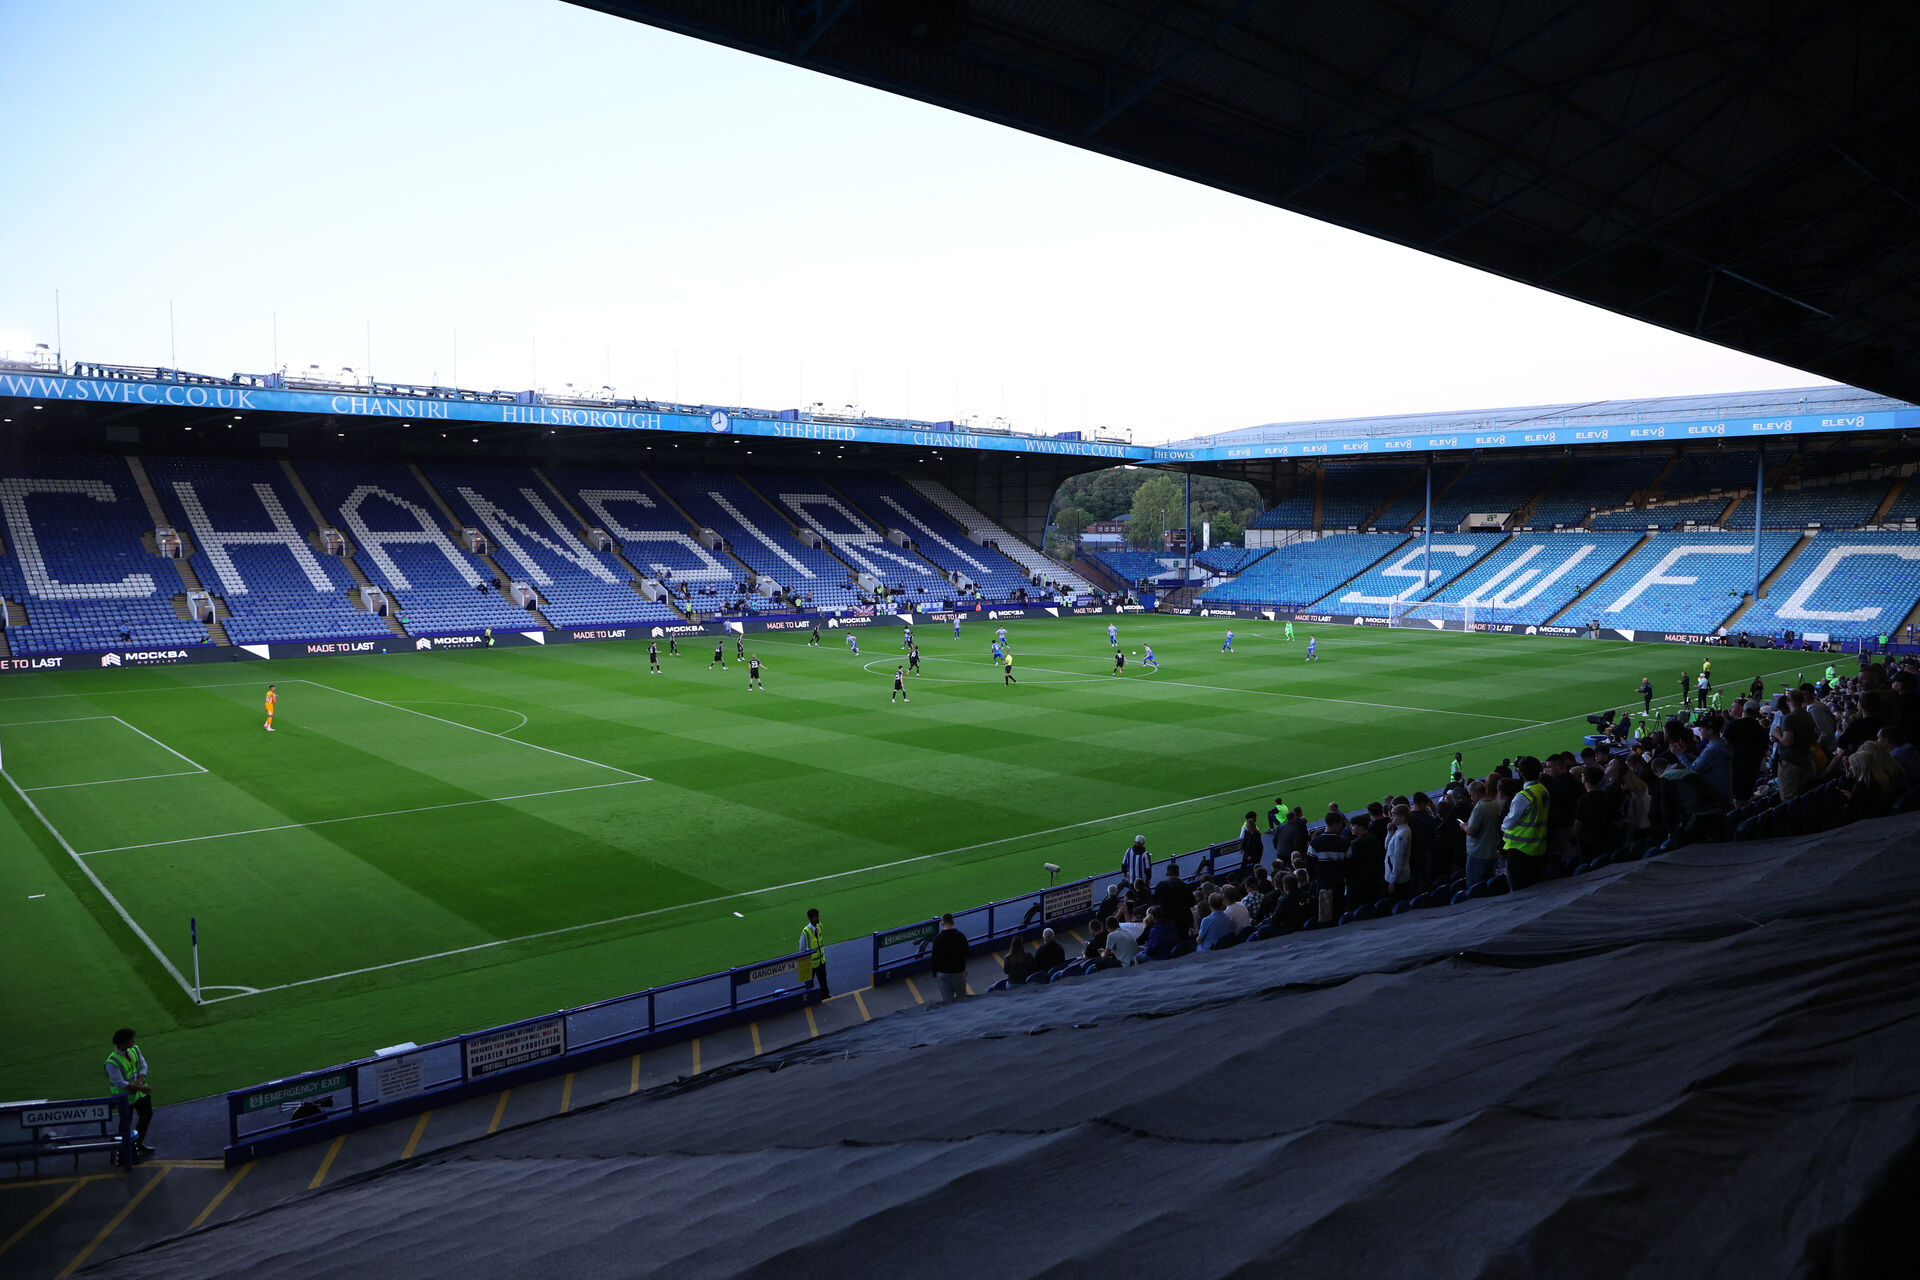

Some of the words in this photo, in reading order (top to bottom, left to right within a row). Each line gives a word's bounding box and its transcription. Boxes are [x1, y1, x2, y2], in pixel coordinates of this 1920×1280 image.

[0, 375, 256, 409] WW.SWFC.CO.UK
[331, 395, 448, 419] CHANSIRI
[502, 405, 661, 430] HILLSBOROUGH
[1822, 416, 1865, 428] ELEV8
[773, 422, 856, 441] SHEFFIELD
[1688, 424, 1726, 435] ELEV8
[1753, 420, 1792, 432] ELEV8
[1525, 432, 1556, 443] ELEV8
[1576, 430, 1609, 440] ELEV8
[1630, 427, 1665, 438] ELEV8
[913, 432, 978, 448] CHANSIRI
[1385, 439, 1412, 449] ELEV8
[1430, 437, 1458, 447] ELEV8
[1476, 435, 1506, 446] ELEV8
[1025, 440, 1125, 458] WWW.SWFC.CO.UK
[1265, 446, 1288, 455] ELEV8
[1303, 444, 1327, 454] ELEV8
[1343, 442, 1368, 451] ELEV8
[1170, 451, 1194, 459] OWLS
[1229, 448, 1251, 457] ELEV8
[665, 625, 704, 633] MOCKBA
[795, 620, 810, 628] LAST
[573, 630, 597, 639] MADE
[597, 630, 606, 638] TO
[607, 629, 626, 638] LAST
[1539, 626, 1577, 634] MOCKBA
[434, 636, 482, 645] MOCKBA
[1665, 634, 1686, 642] MADE
[1687, 635, 1699, 643] TO
[307, 643, 335, 653] MADE
[336, 643, 350, 652] TO
[351, 641, 375, 651] LAST
[125, 650, 188, 661] MOCKBA
[13, 659, 29, 669] TO
[32, 657, 62, 668] LAST
[752, 964, 787, 980] GANGWAY
[788, 962, 796, 970] 14
[264, 1081, 318, 1103] EMERGENCY
[321, 1073, 341, 1089] EXIT
[27, 1109, 88, 1123] GANGWAY
[92, 1107, 105, 1118] 13
